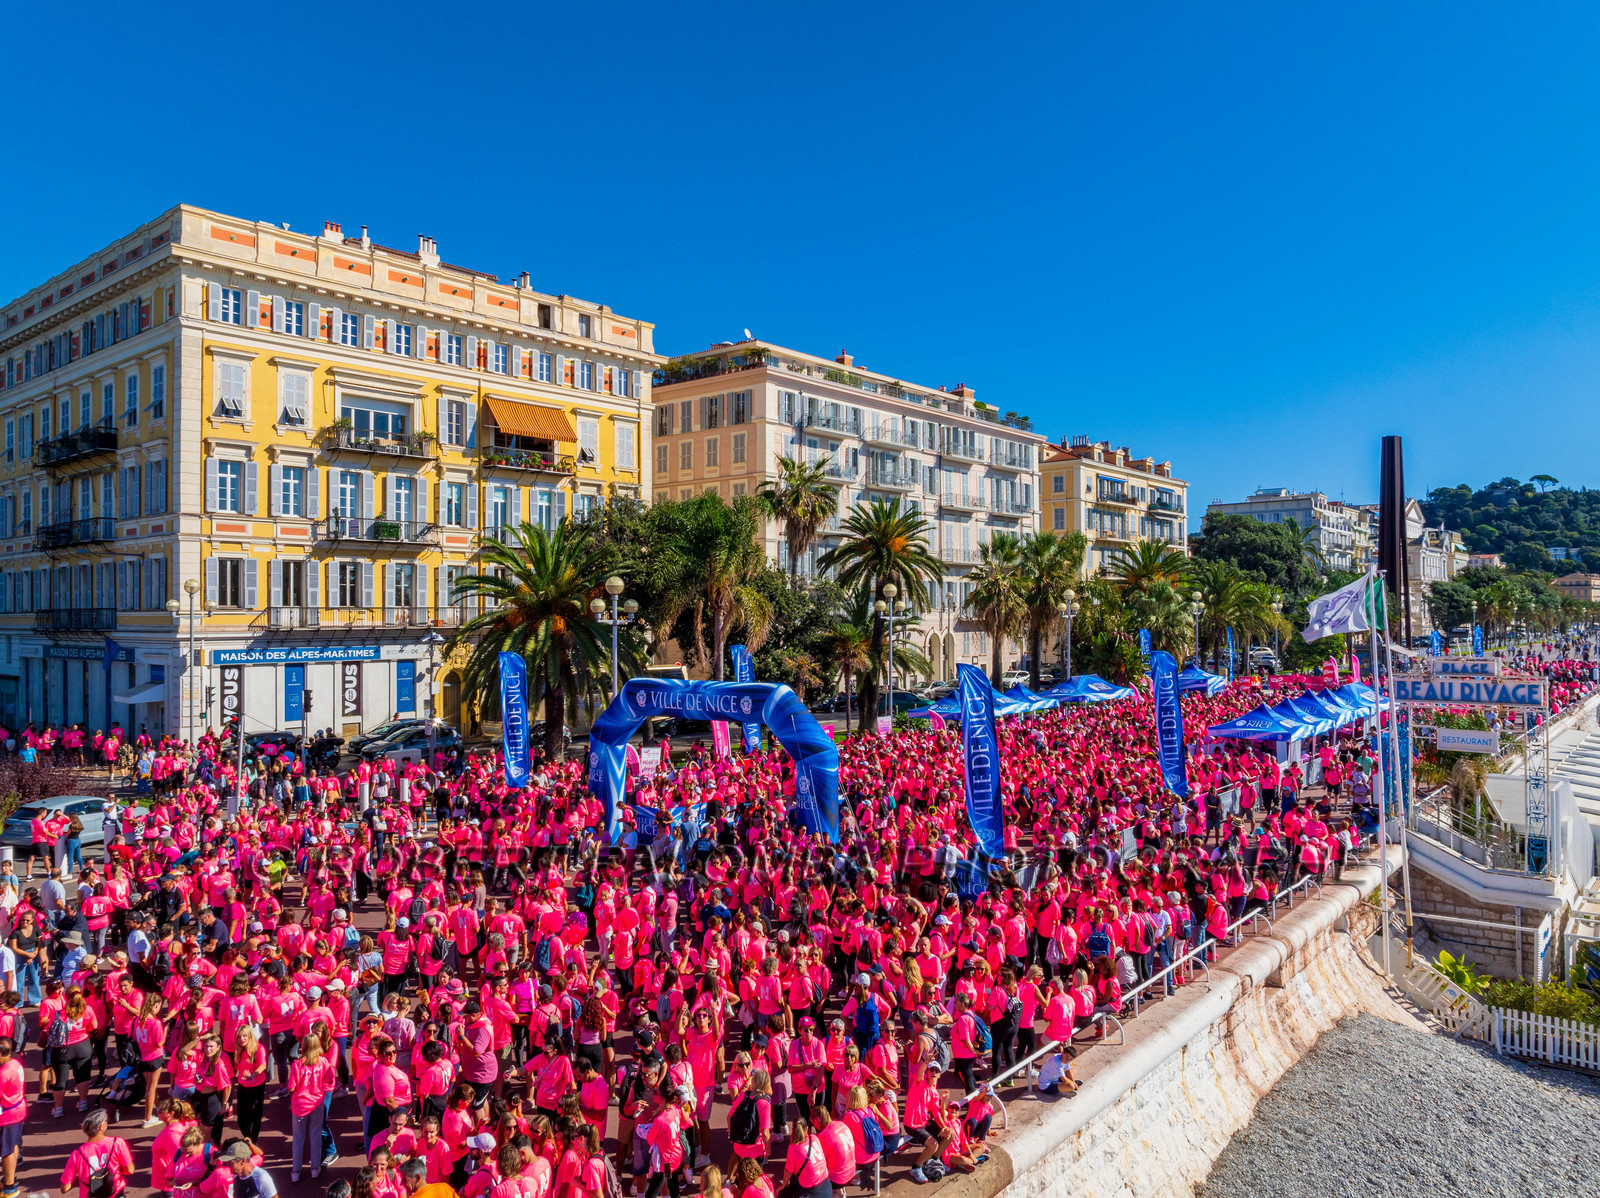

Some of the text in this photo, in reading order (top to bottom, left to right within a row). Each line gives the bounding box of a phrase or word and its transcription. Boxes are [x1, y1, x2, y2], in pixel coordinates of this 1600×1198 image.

[80, 649, 126, 661] ALPES-MAES
[220, 648, 375, 661] MAISON DES ALPES-MARITIMES
[1442, 663, 1489, 674] PLAGE
[223, 668, 239, 723] VOUS
[345, 664, 357, 714] VOUS
[1396, 680, 1540, 705] BEAU RIVAGE
[650, 686, 738, 713] VILLE DE NICE
[506, 671, 524, 764] VILLE DE NICE
[1159, 671, 1180, 771] VILLE DE NICE
[1442, 735, 1493, 746] RESTAURANT
[969, 692, 994, 824] VILLE DE NICE
[116, 884, 126, 900] N
[93, 904, 104, 915] N
[459, 917, 467, 930] N
[503, 921, 514, 934] N
[760, 986, 770, 1001] N
[231, 1005, 244, 1021] N
[280, 1001, 294, 1017] N
[1063, 1003, 1073, 1018] N
[136, 1028, 149, 1044] N
[838, 1130, 854, 1151] N
